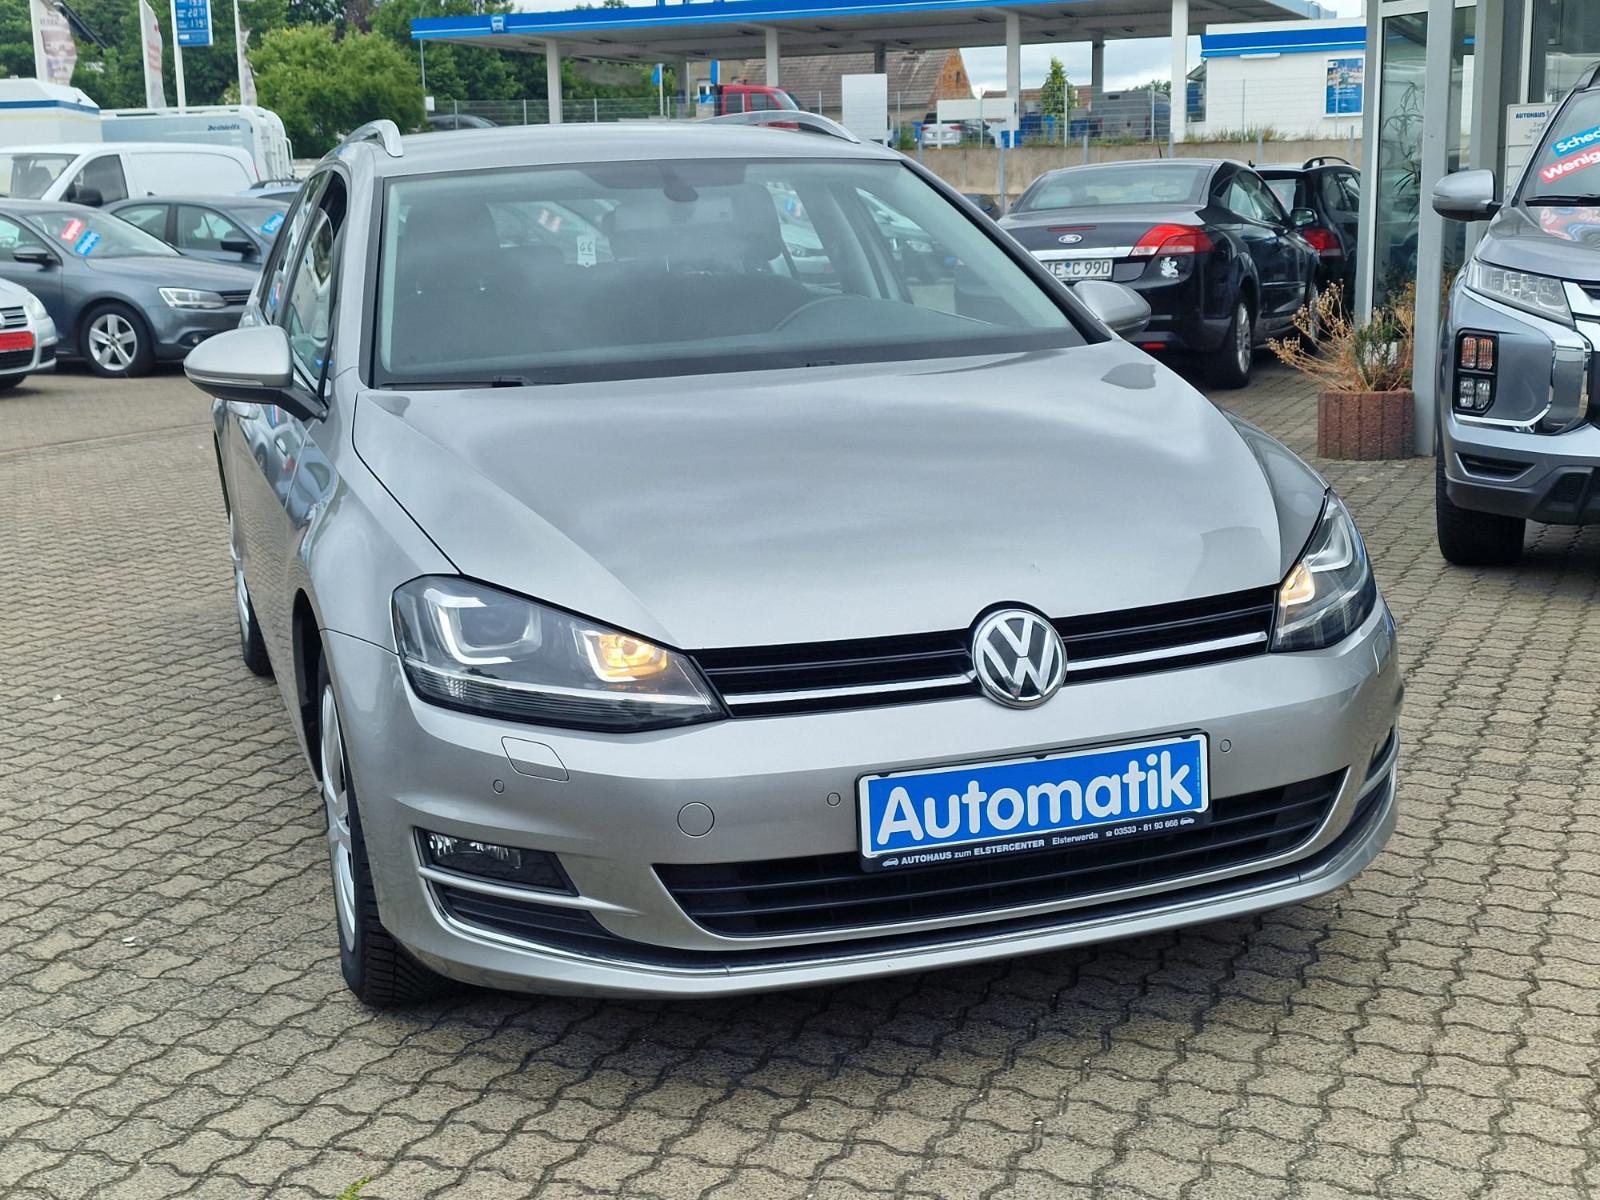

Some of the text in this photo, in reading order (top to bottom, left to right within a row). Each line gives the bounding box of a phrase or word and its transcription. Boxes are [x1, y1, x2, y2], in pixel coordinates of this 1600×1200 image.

[1072, 262, 1081, 275] C
[1084, 261, 1110, 275] 990
[974, 609, 1064, 704] VW
[876, 750, 1193, 845] Automatik
[901, 851, 952, 865] AUTOHAUS
[954, 849, 972, 859] zum
[973, 839, 1045, 856] ELSTERCENTER
[1052, 832, 1098, 845] Elsterwerda
[1114, 826, 1137, 836] 03533
